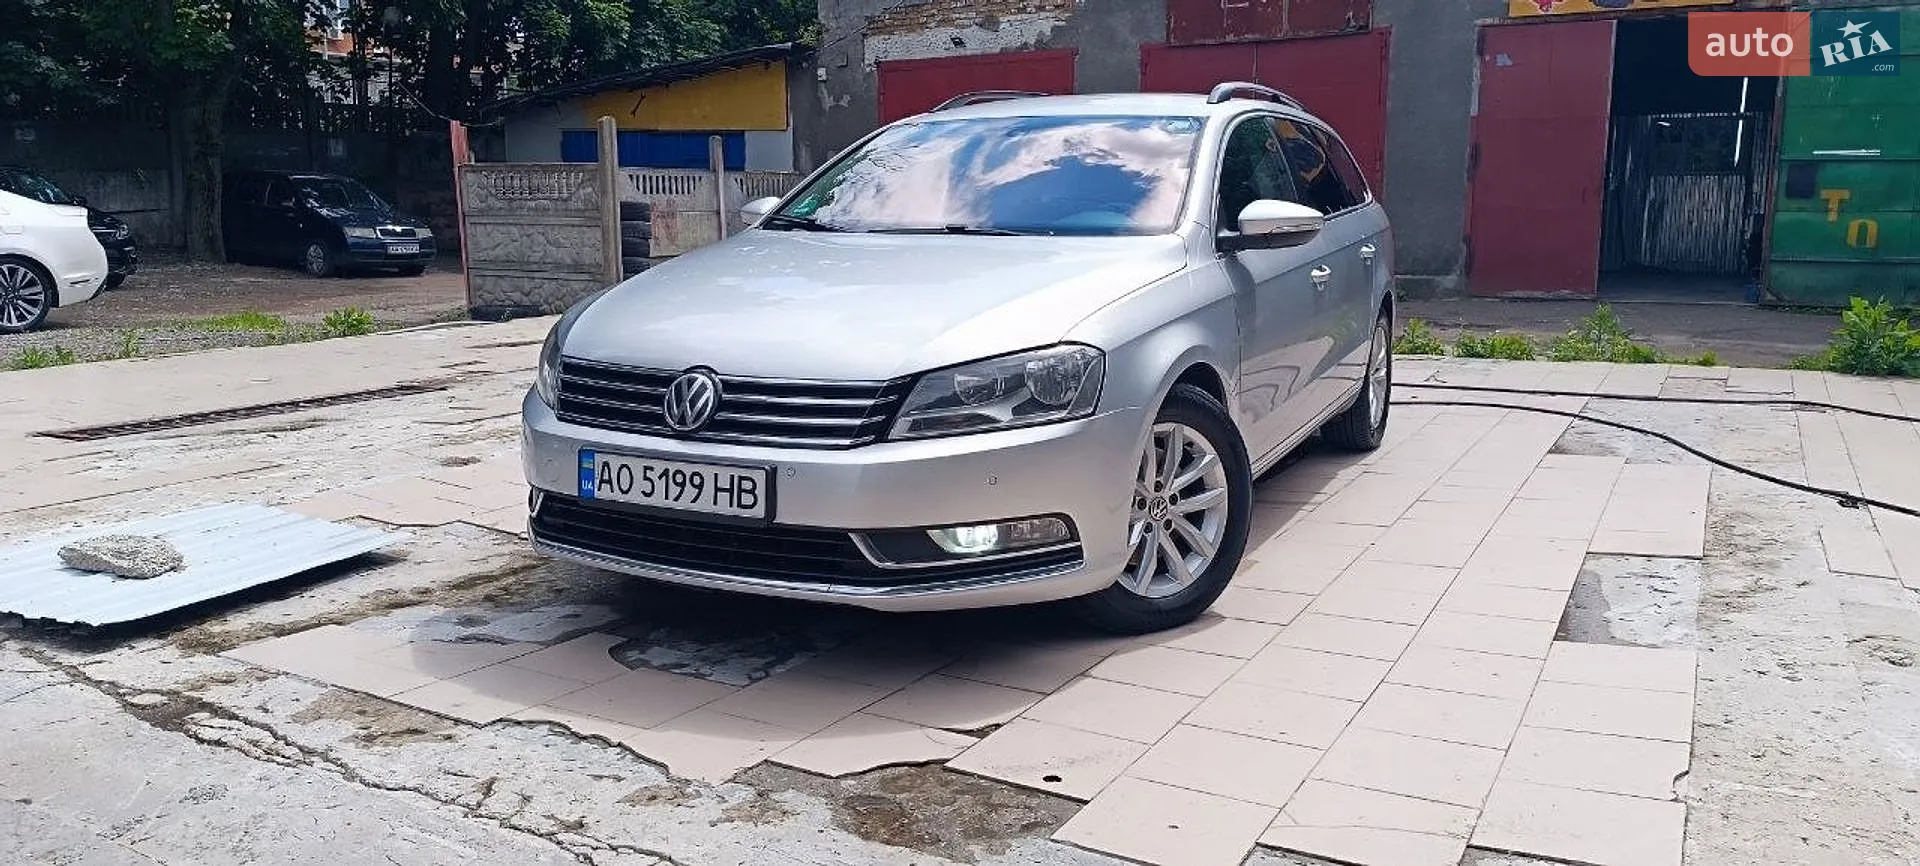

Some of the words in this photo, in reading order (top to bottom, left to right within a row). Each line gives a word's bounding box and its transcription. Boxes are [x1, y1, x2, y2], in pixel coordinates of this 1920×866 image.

[597, 461, 634, 495] AO
[641, 465, 705, 504] 5199
[713, 472, 758, 510] HB
